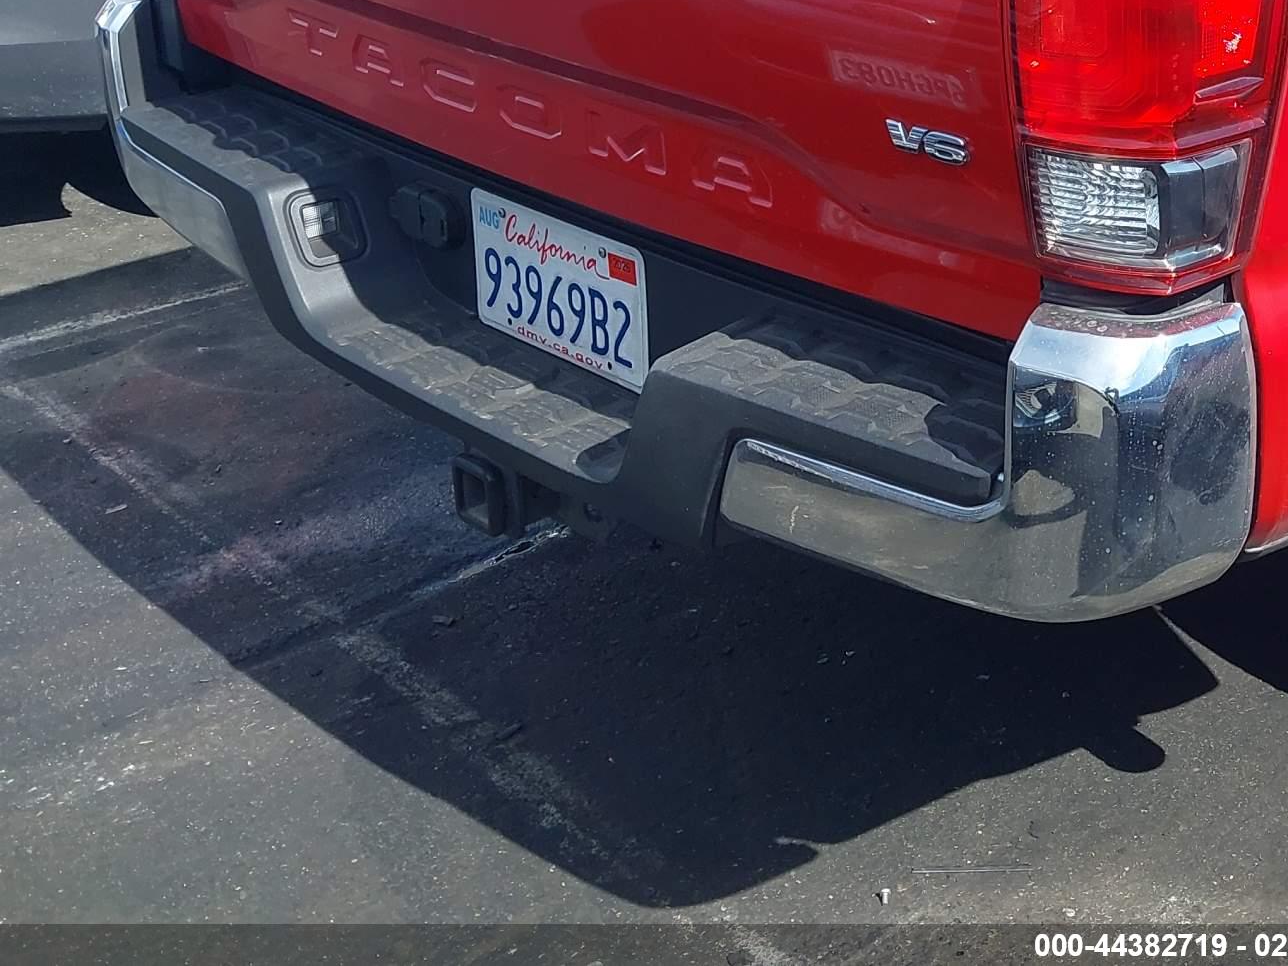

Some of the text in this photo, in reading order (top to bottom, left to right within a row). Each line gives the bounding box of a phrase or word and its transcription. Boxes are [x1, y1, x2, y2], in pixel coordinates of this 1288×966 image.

[288, 8, 774, 208] TACOMA
[885, 117, 970, 165] V6
[479, 206, 500, 230] AUG
[505, 214, 610, 280] California
[484, 247, 633, 369] 93969B2
[516, 324, 603, 370] dmv.ca.gov
